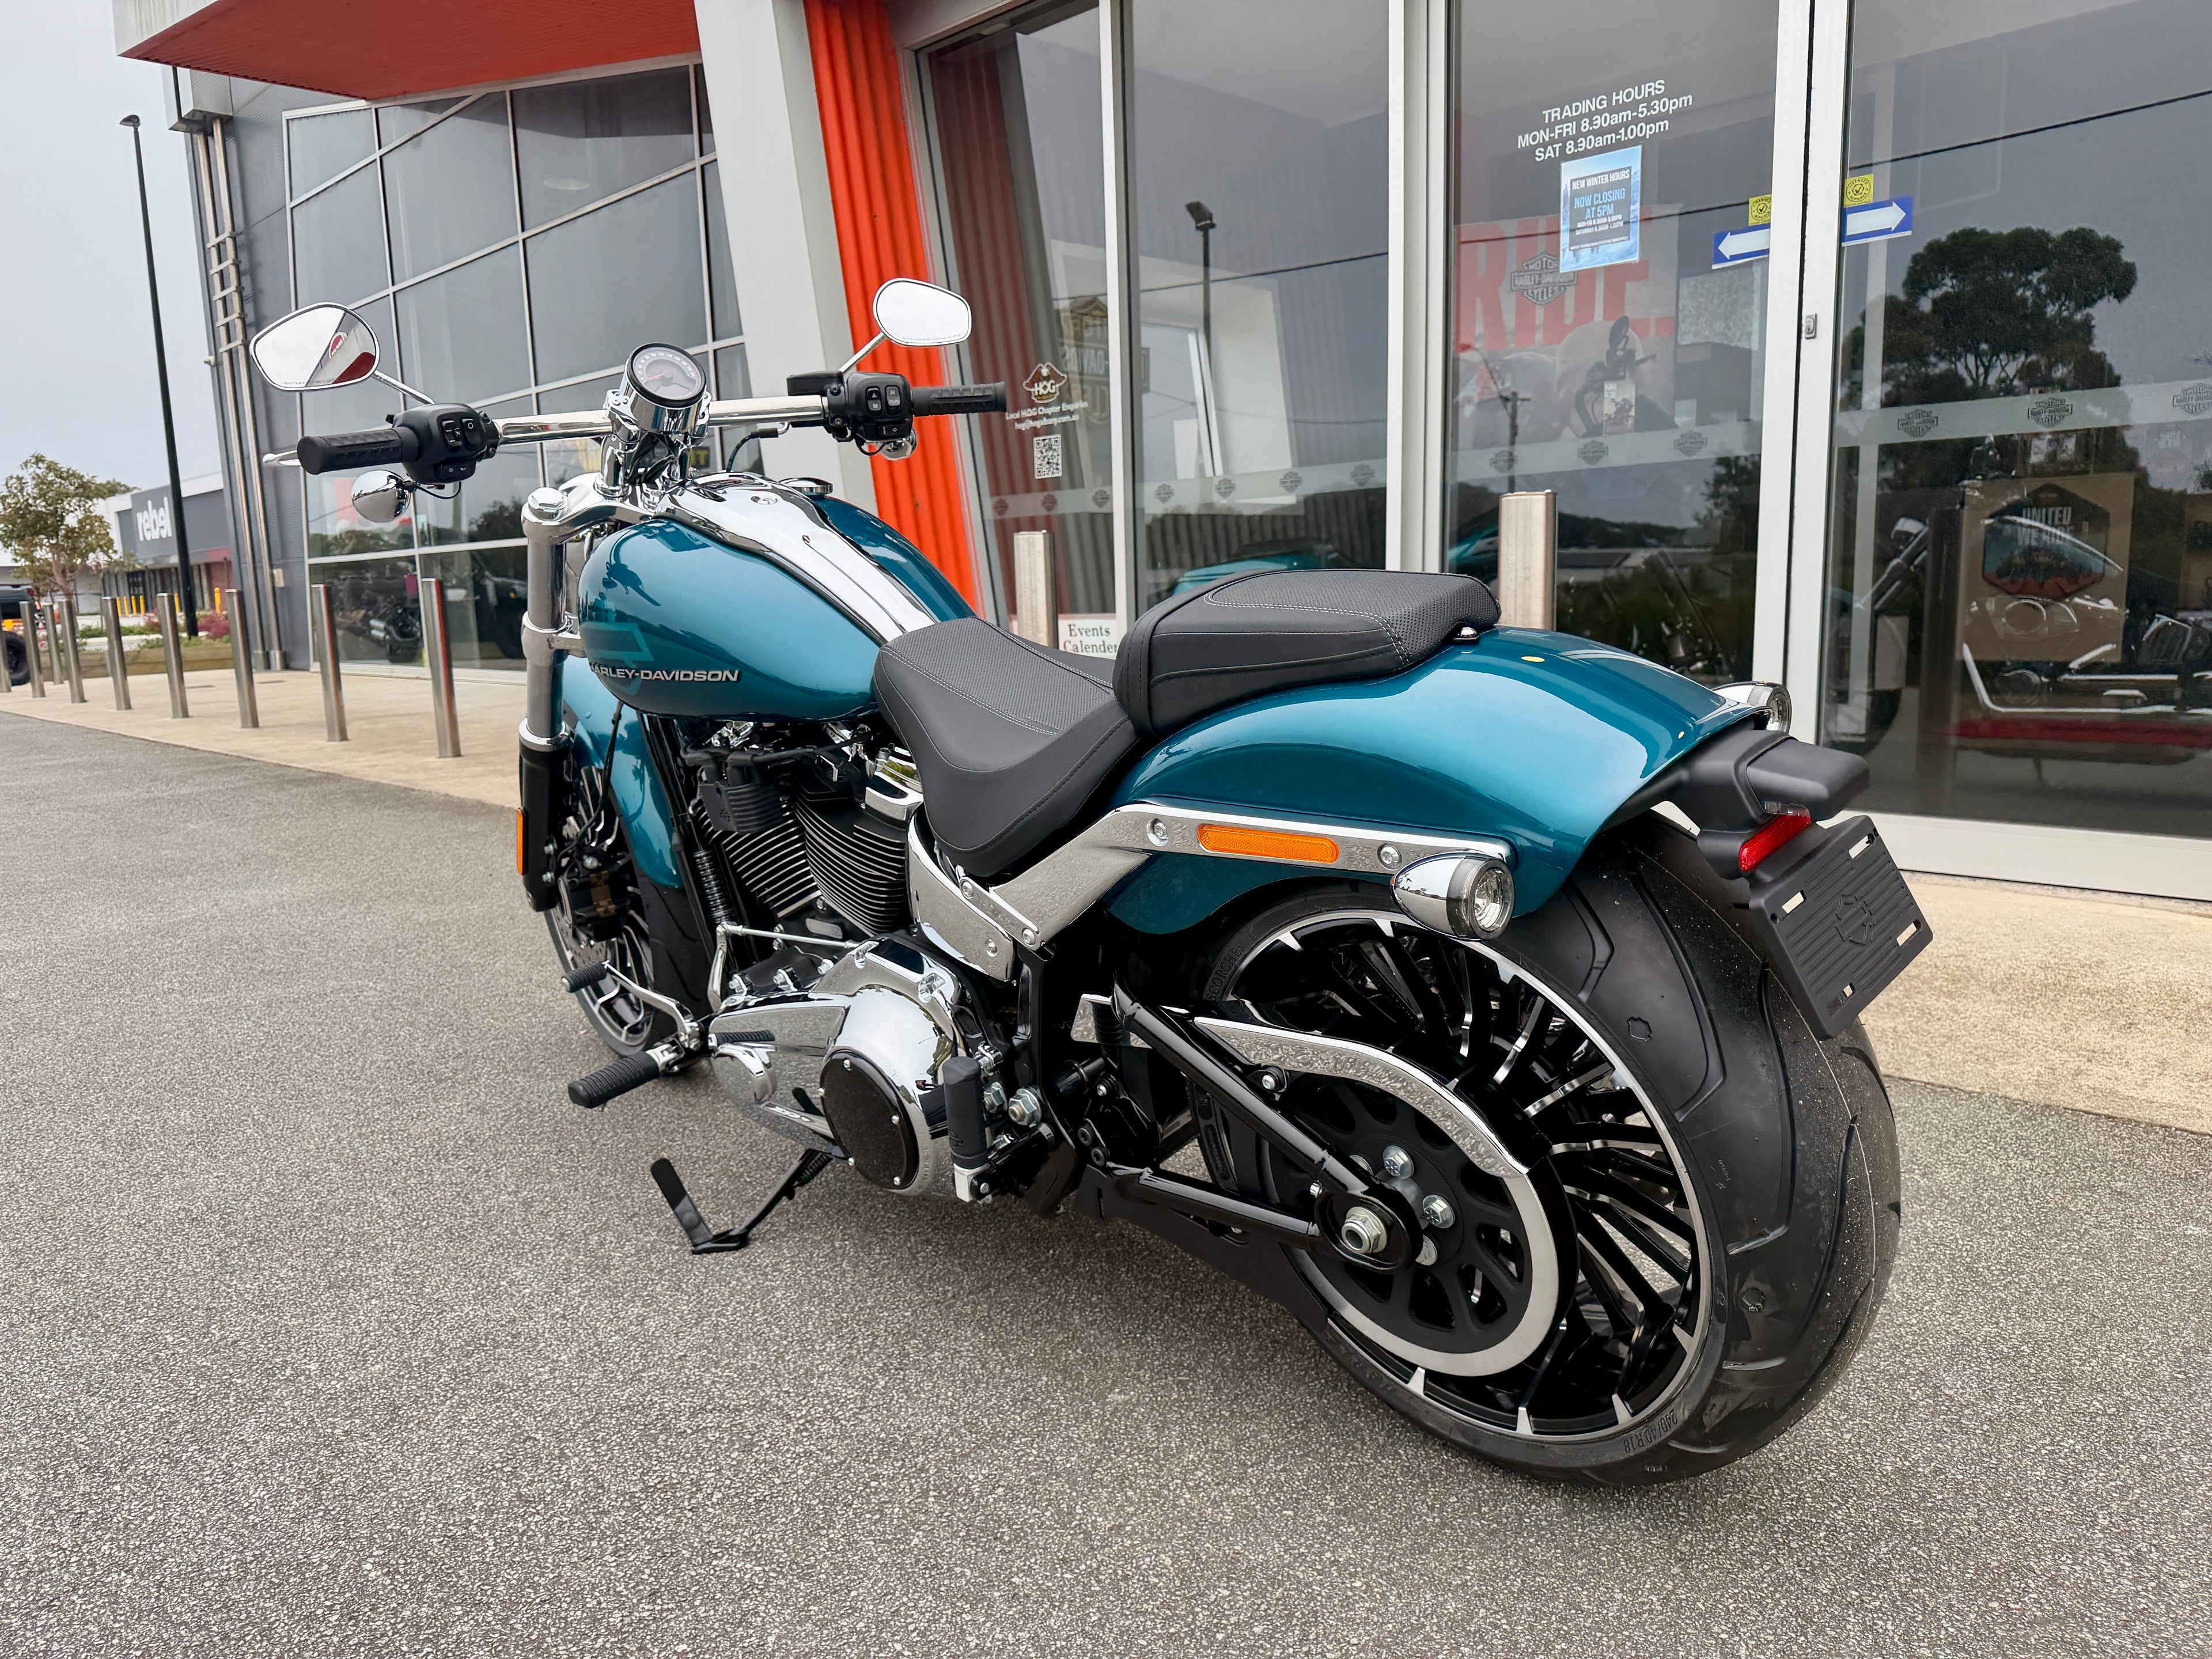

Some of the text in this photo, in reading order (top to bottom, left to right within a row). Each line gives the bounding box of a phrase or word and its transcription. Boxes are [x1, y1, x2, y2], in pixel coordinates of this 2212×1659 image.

[1542, 79, 1665, 124] TRADING HOURS
[1517, 122, 1576, 149] MON-FRI
[1535, 143, 1562, 161] SAT
[1572, 169, 1630, 190] NEW WINTER HOURS
[1574, 187, 1625, 209] NOW CLOSING
[1585, 203, 1614, 219] AT 5PM
[1033, 380, 1056, 395] HOG
[137, 497, 172, 541] rebel
[1067, 623, 1111, 637] Events
